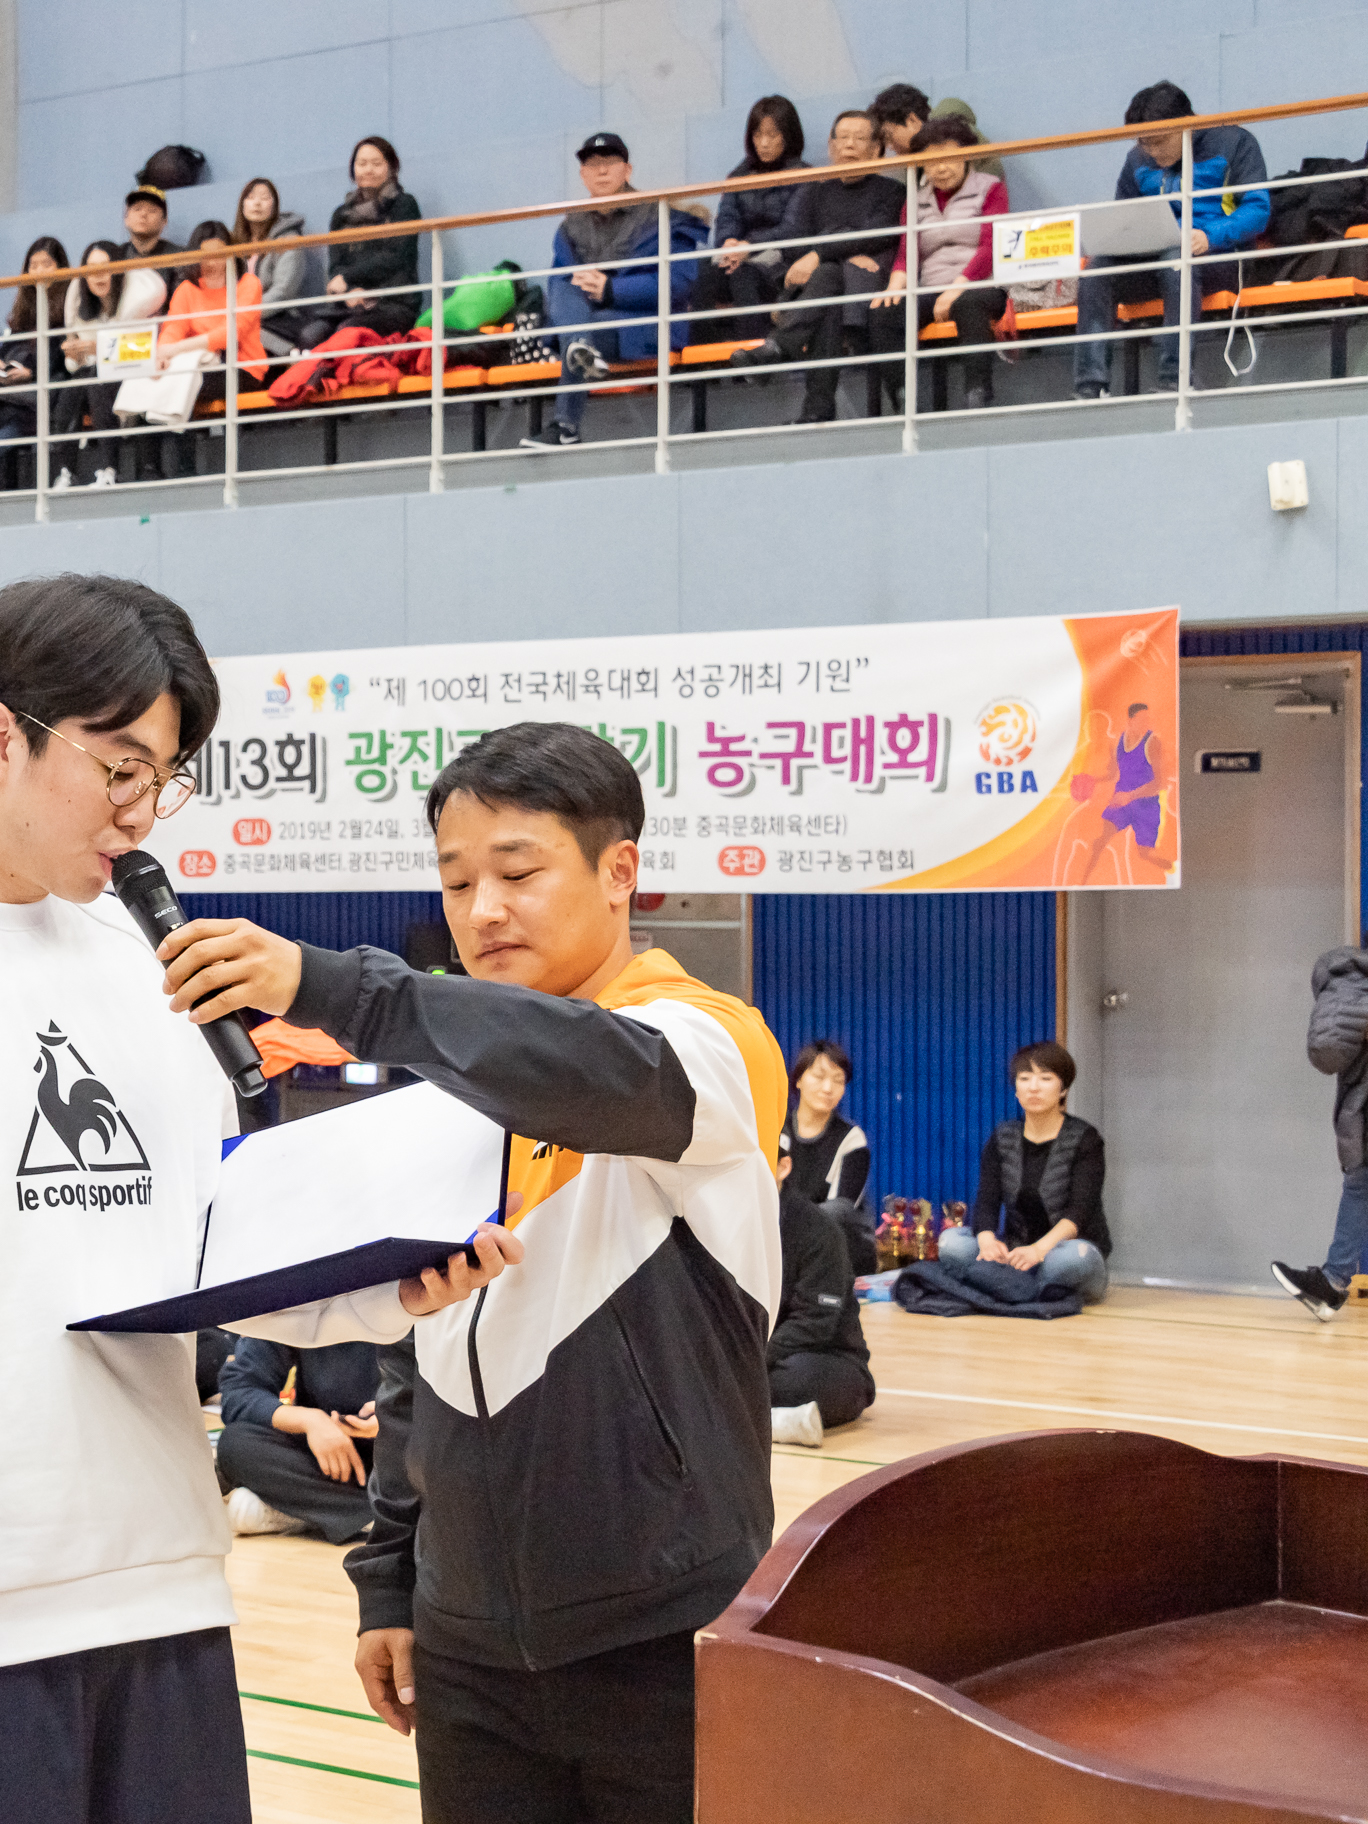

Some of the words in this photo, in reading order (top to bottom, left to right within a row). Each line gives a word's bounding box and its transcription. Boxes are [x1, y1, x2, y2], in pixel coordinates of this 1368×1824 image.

[417, 673, 488, 704] 100회
[499, 666, 658, 704] 전국체육대회
[671, 661, 783, 698] 성공개최
[697, 711, 940, 789] 농구대회
[974, 769, 1039, 795] GBA
[236, 819, 270, 844] 일시
[278, 819, 332, 841] 2019년
[182, 852, 214, 876] 장소
[721, 849, 762, 873] 주관
[776, 849, 916, 873] 광진구농구협회
[15, 1181, 40, 1212] le
[43, 1183, 87, 1212] coq
[89, 1175, 153, 1212] sportif
